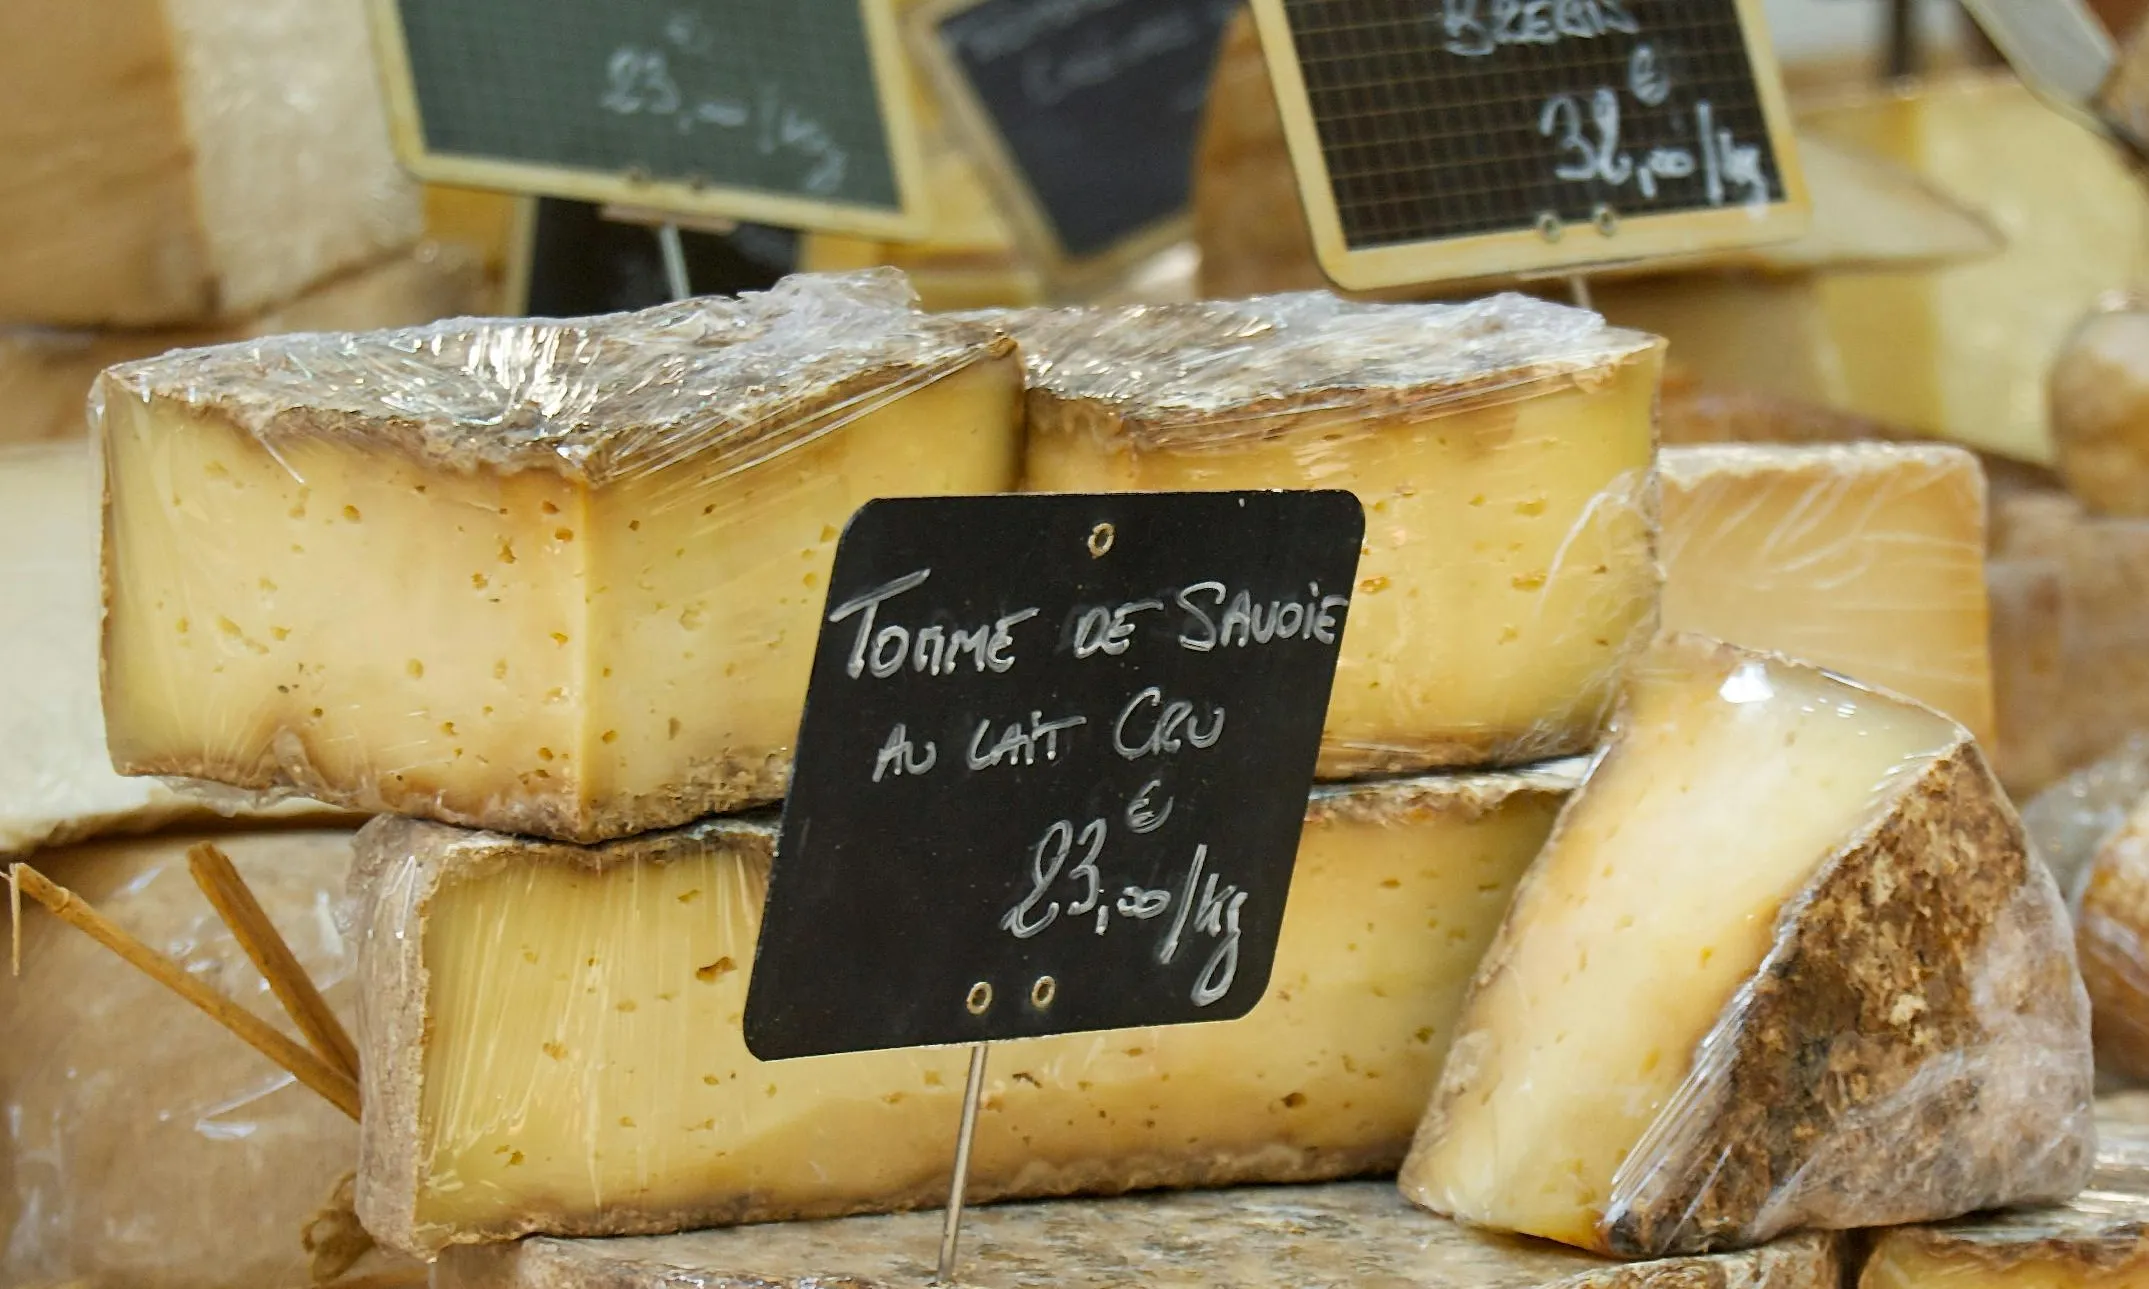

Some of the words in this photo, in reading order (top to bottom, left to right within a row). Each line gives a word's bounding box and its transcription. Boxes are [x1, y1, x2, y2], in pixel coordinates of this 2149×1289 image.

[1073, 599, 1165, 659] DE
[872, 723, 937, 783] AU
[1113, 686, 1226, 761] CRU
[1126, 779, 1174, 834] €
